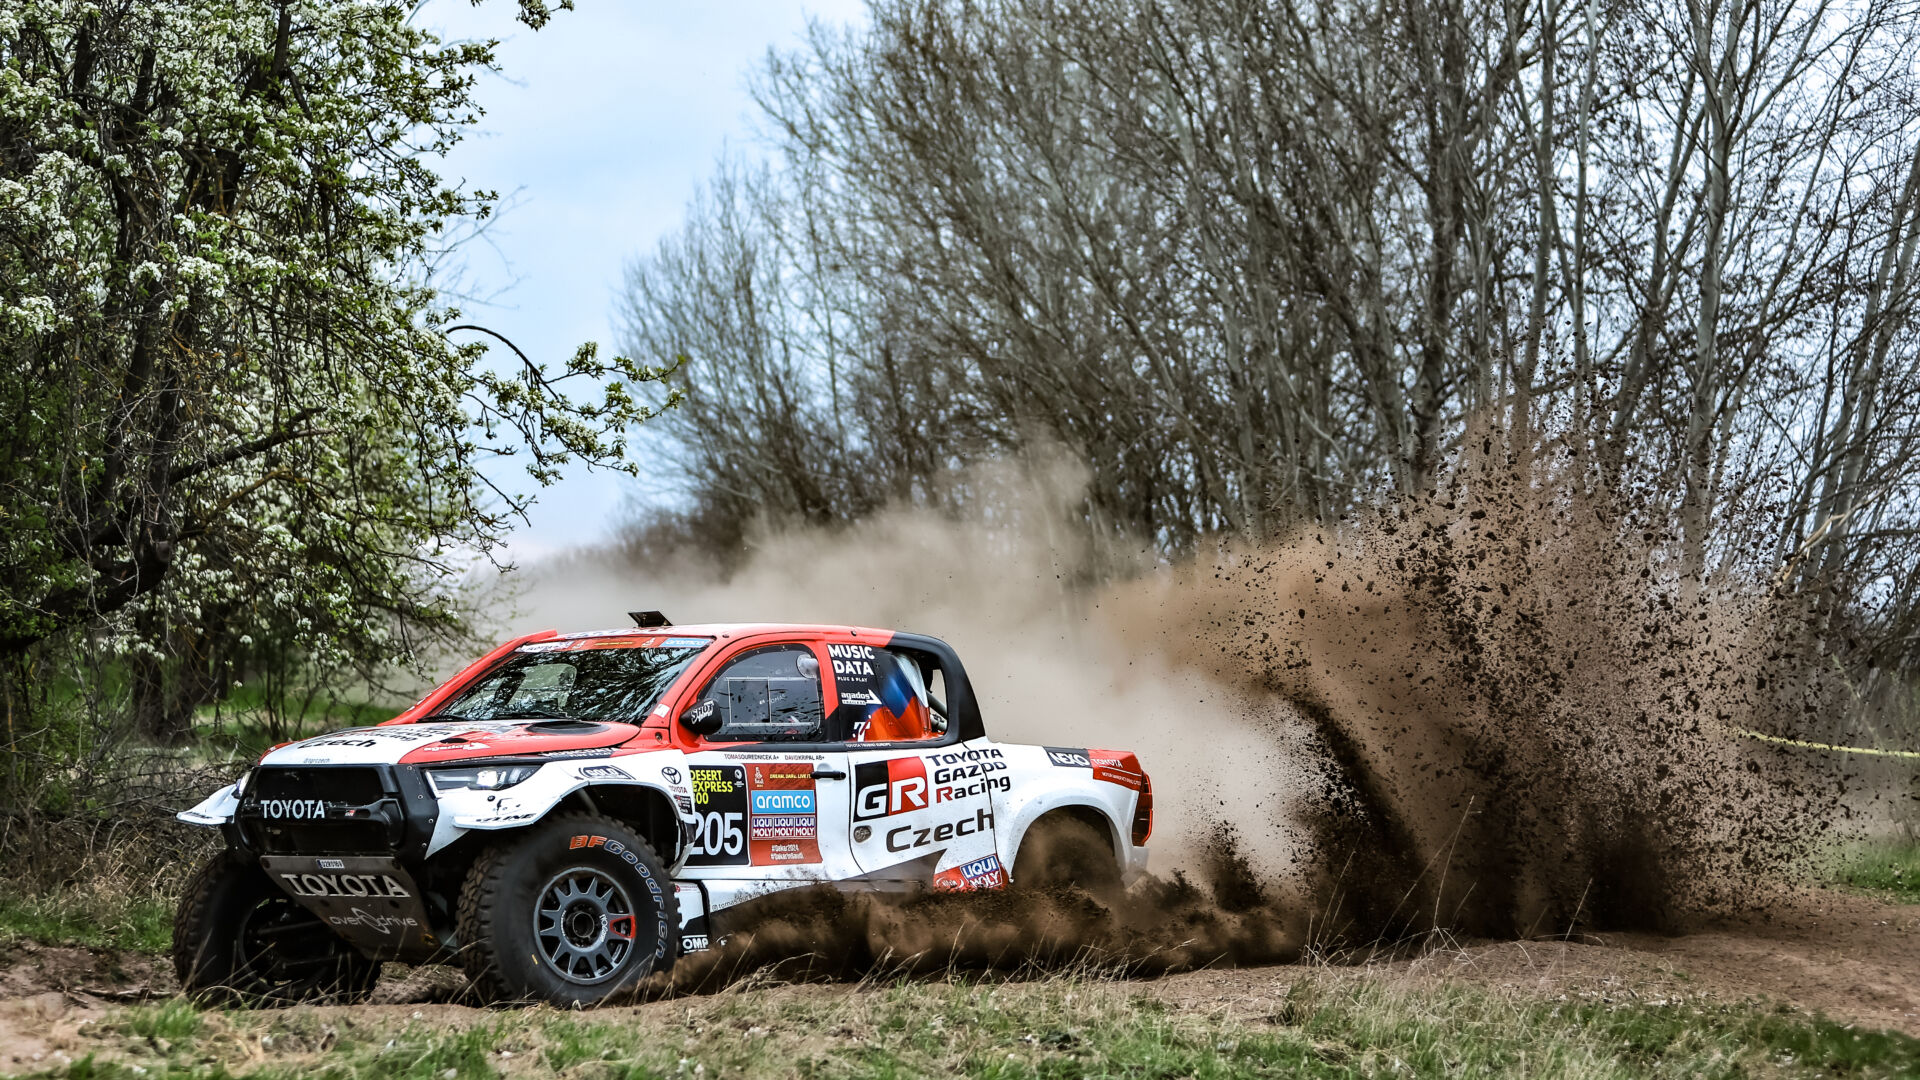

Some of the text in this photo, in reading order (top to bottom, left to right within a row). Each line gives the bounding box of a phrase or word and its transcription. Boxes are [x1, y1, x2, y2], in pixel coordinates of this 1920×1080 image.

[827, 644, 875, 660] MUSIC
[832, 659, 875, 675] DATA
[841, 691, 870, 701] agados
[690, 700, 715, 725] SHOT
[925, 749, 1004, 767] TOYOTA
[1047, 752, 1091, 766] NEXO
[1090, 758, 1124, 768] TOYOTA
[690, 769, 722, 781] DESERT
[934, 762, 1008, 785] GAZOO
[692, 781, 733, 792] EXPRESS
[936, 776, 1011, 803] Racing
[756, 794, 811, 809] aramco
[856, 776, 927, 818] GR
[260, 799, 326, 819] TOYOTA
[753, 818, 815, 827] LIQUI LIQUI LIQUI
[886, 808, 995, 852] Czech
[690, 811, 743, 856] 205
[753, 828, 815, 837] MOLY MOLY MOLY
[961, 856, 999, 879] LIQUI
[280, 874, 412, 897] TOYOTA
[970, 870, 1000, 888] MOLY
[682, 938, 709, 949] OMP
